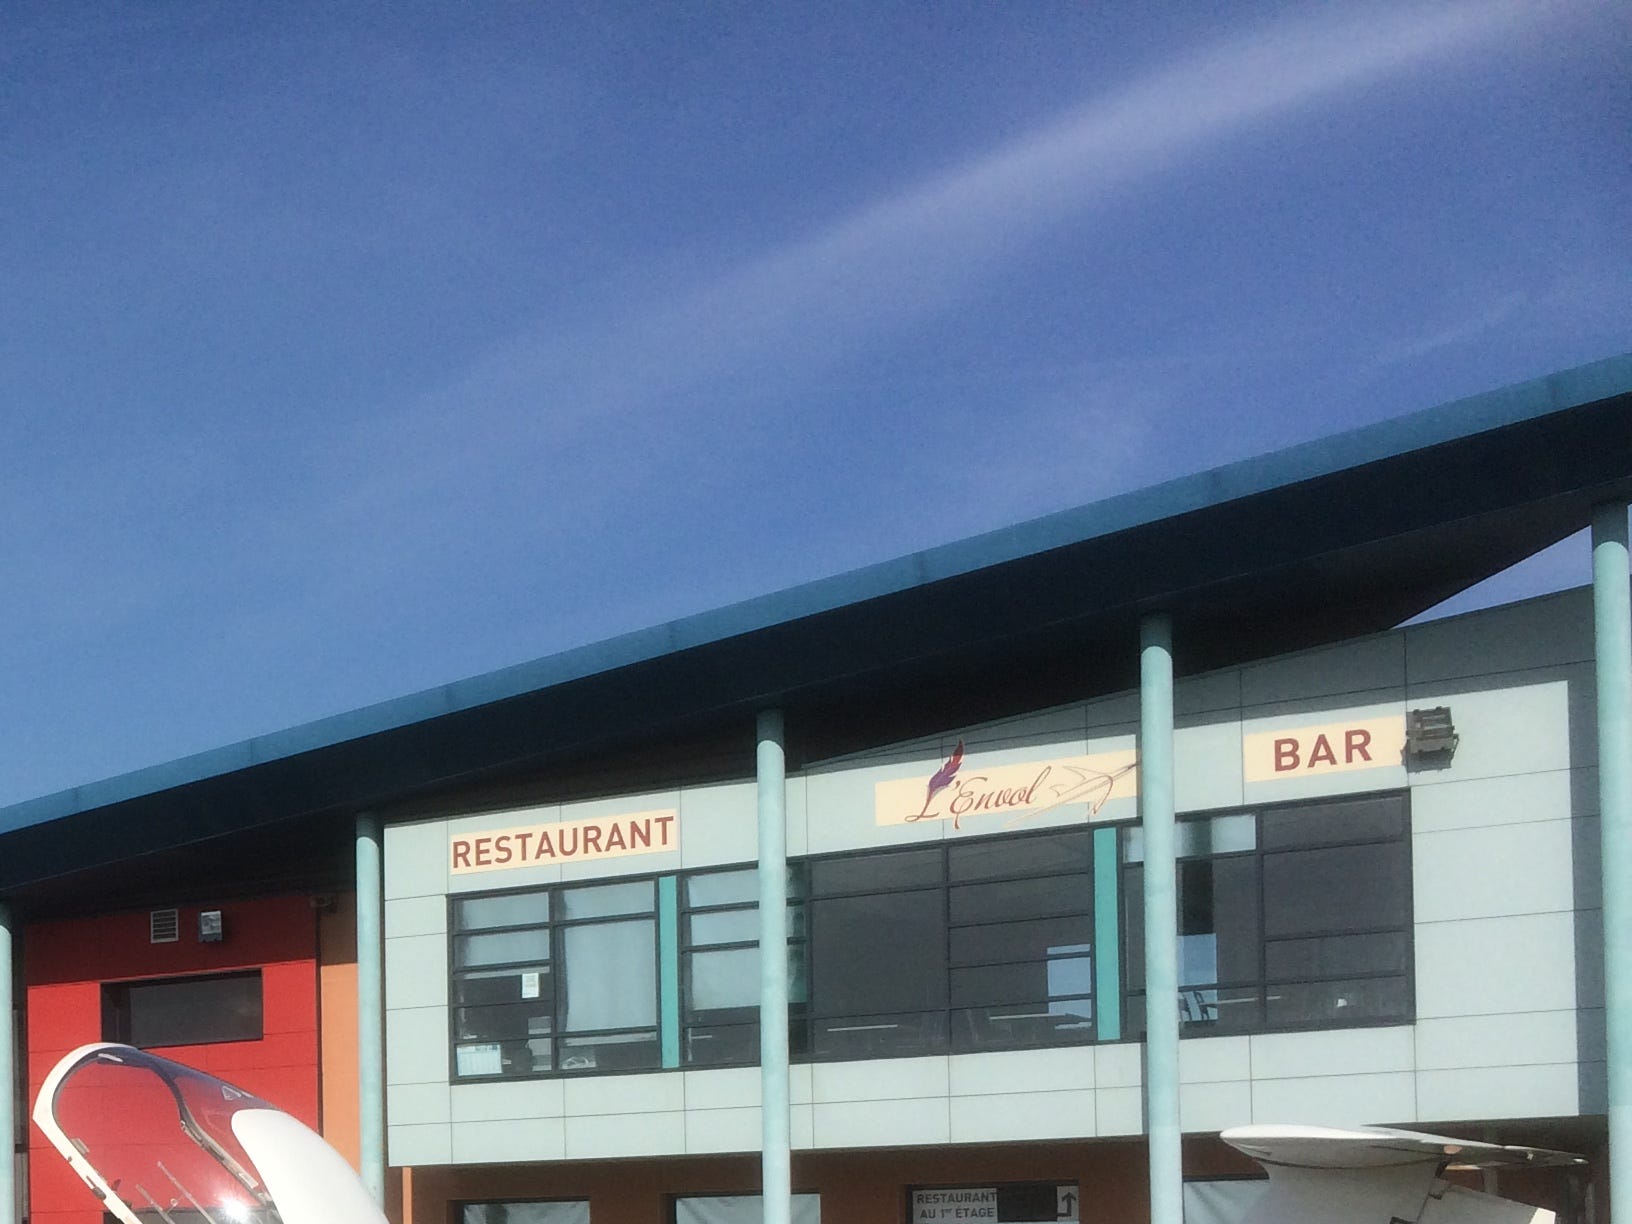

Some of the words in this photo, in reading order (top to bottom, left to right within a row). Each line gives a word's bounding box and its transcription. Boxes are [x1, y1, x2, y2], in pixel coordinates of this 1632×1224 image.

[1274, 728, 1373, 772] BAR
[905, 765, 1052, 830] L'Envol
[452, 815, 674, 869] RESTAURANT
[916, 1191, 997, 1204] RESTAURANT
[920, 1208, 936, 1219] AU
